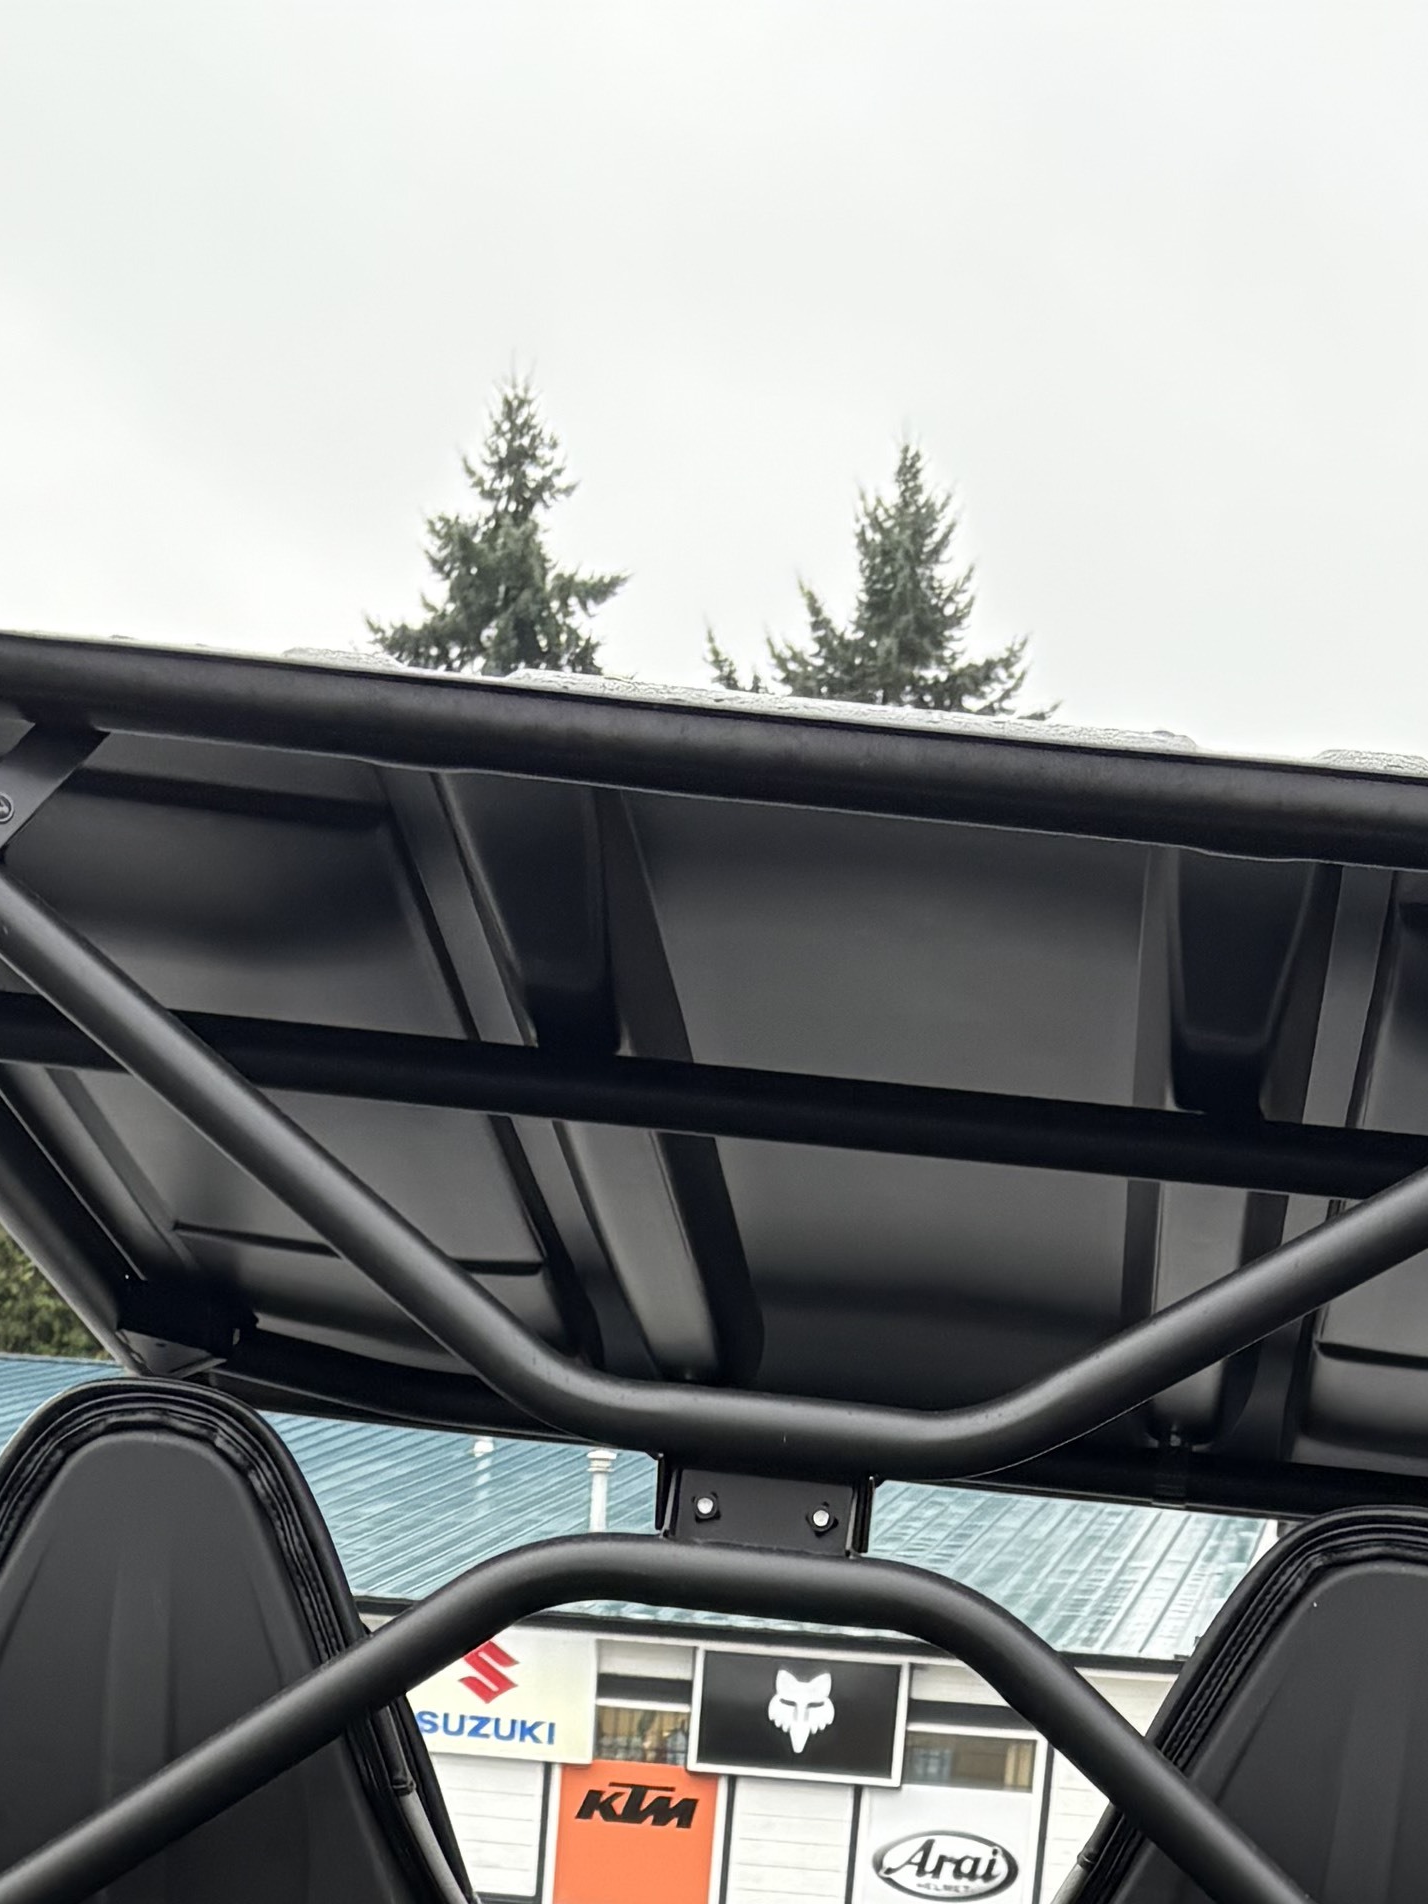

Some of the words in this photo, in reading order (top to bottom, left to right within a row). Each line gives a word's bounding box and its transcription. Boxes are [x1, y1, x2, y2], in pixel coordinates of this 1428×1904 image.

[416, 1710, 556, 1746] SUZUKI
[575, 1781, 699, 1829] KTM
[884, 1839, 1001, 1883] Arai
